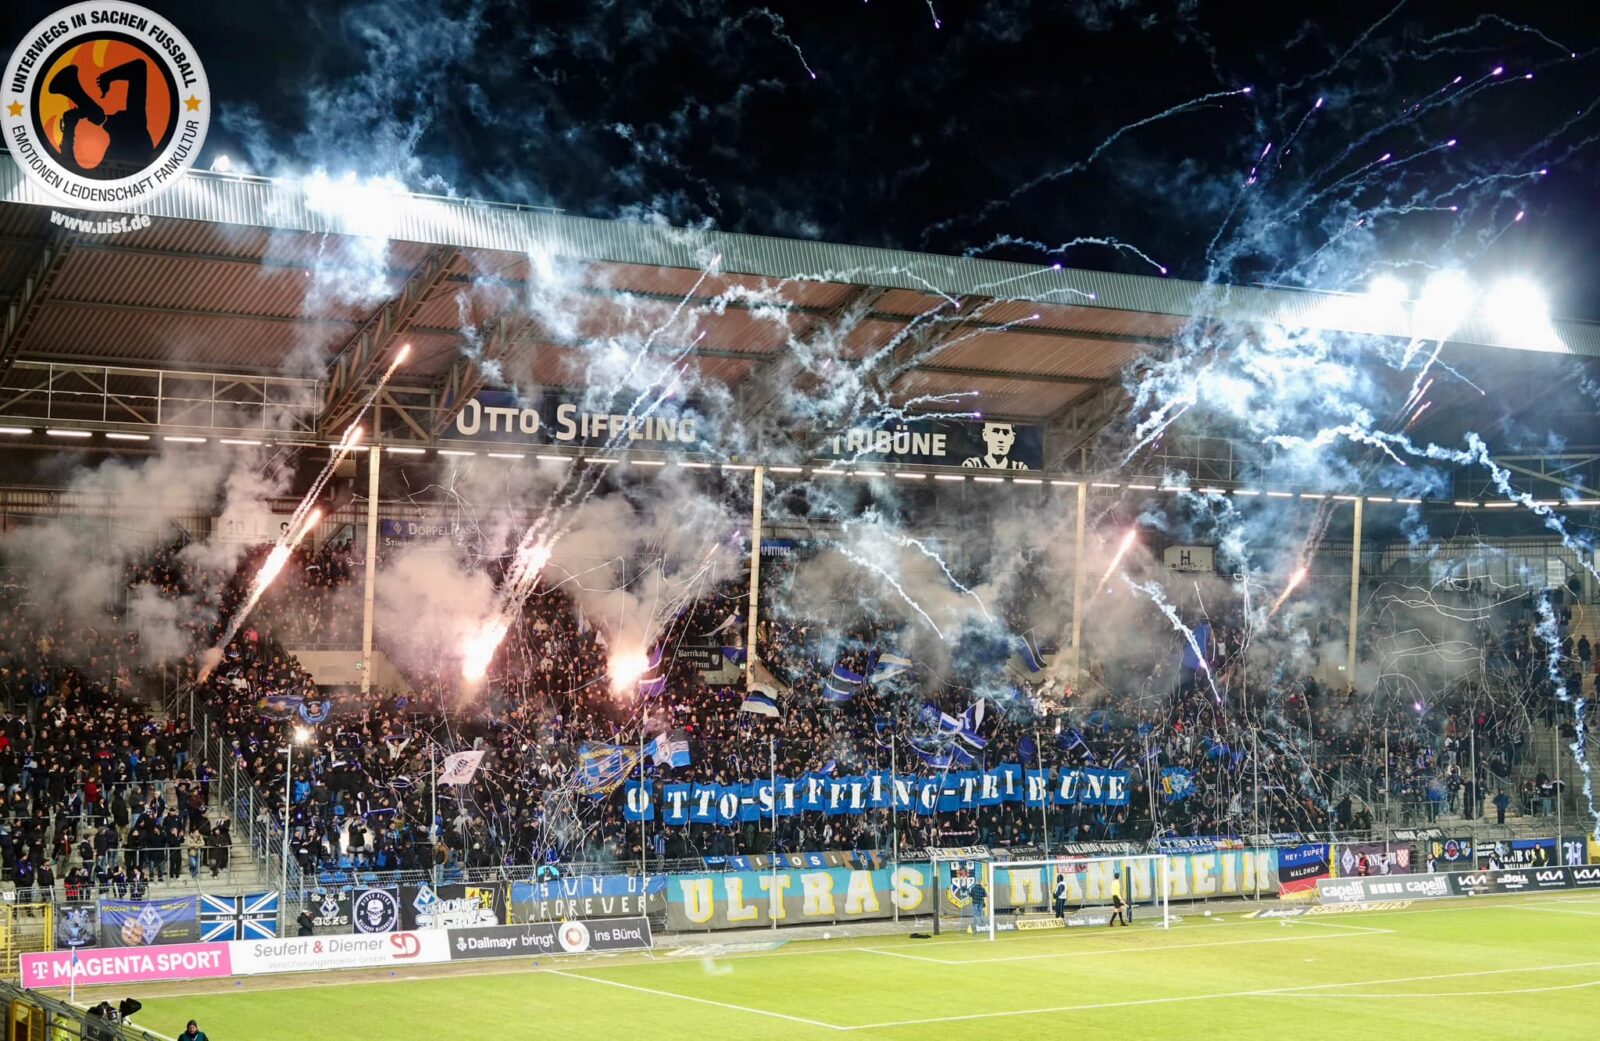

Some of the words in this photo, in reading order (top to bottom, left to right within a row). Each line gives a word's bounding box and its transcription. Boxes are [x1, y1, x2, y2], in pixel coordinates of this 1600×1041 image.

[456, 398, 540, 436] OTTO
[556, 404, 696, 443] SIFFLING
[1290, 866, 1320, 878] WALDHOF
[680, 867, 924, 924] ULTRAS
[1321, 880, 1365, 899] capelli
[1406, 876, 1447, 894] capelli
[254, 941, 308, 958] Seufert
[312, 940, 324, 954] &
[329, 938, 384, 953] Diemer
[468, 935, 518, 950] Dallmayr
[521, 933, 555, 947] bringt
[594, 930, 612, 942] ins
[613, 927, 641, 942] Büro!
[53, 954, 155, 979] MAGENTA
[157, 950, 222, 972] SPORT
